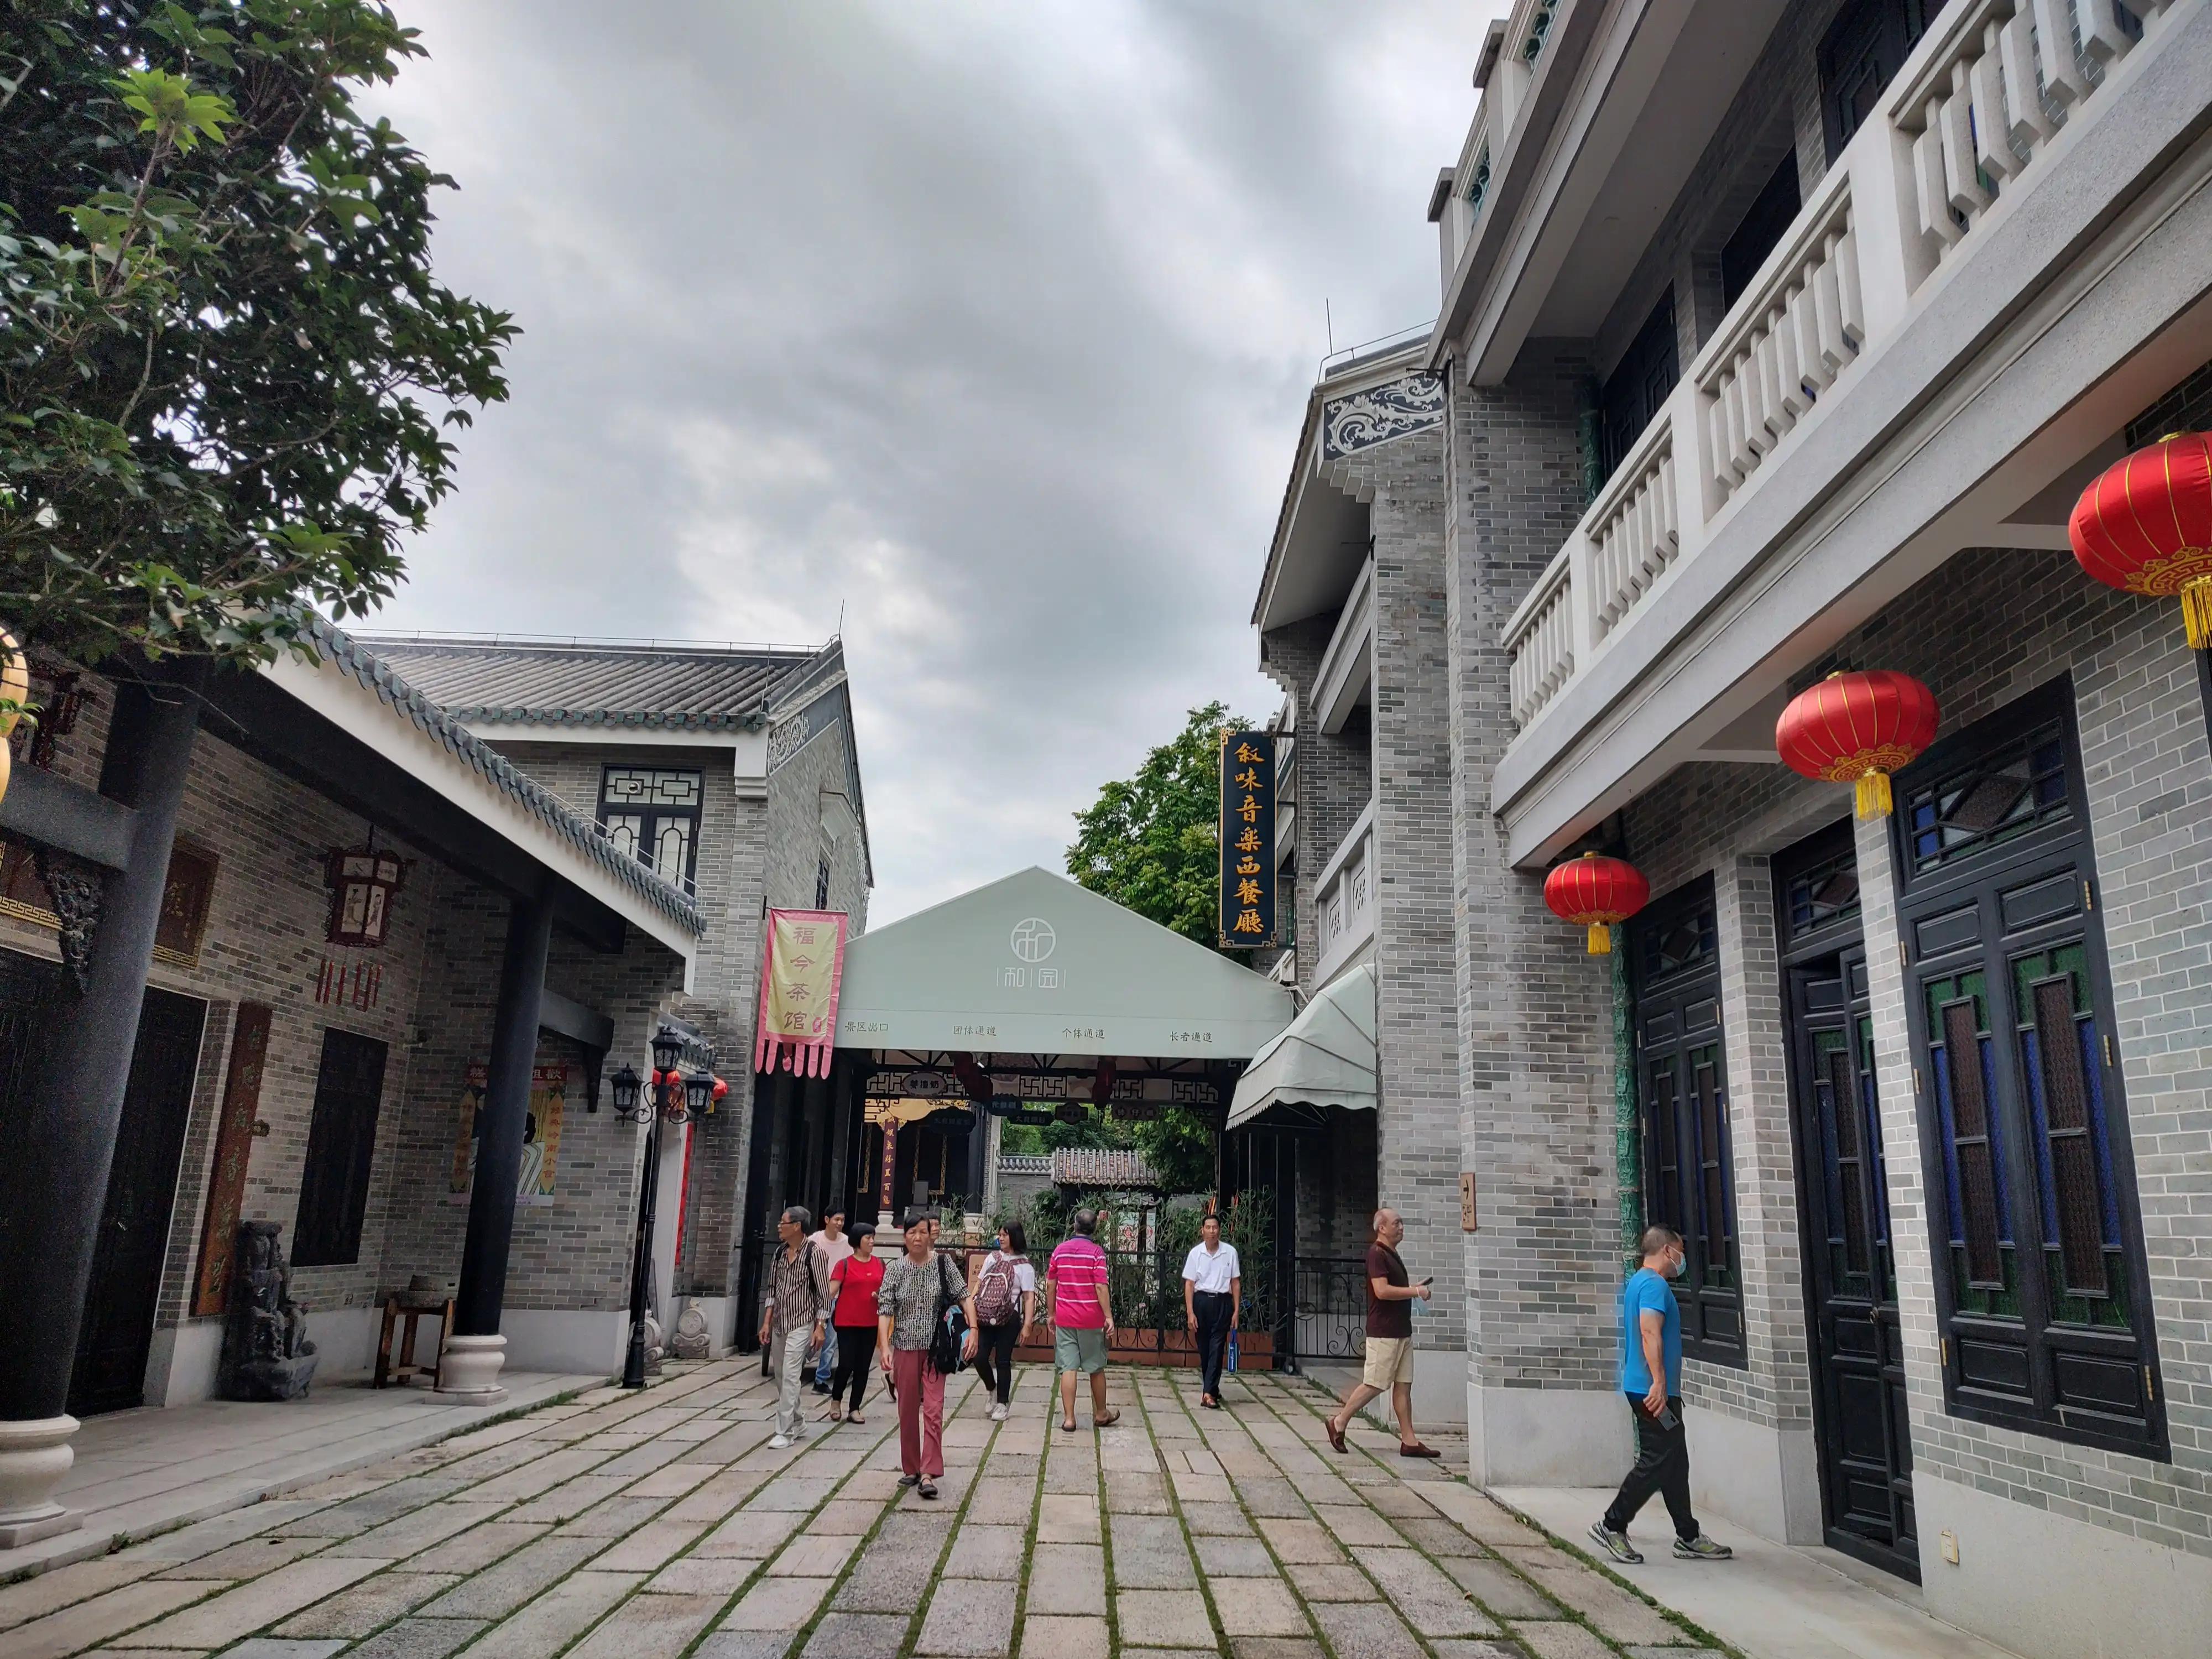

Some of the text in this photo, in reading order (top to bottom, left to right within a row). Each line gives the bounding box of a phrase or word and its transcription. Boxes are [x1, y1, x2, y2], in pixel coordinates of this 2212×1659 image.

[784, 926, 817, 1030] 福今茶馆
[1004, 967, 1058, 988] 和园
[845, 1021, 889, 1032] 景区出口
[953, 1025, 997, 1036] 团体通道
[1062, 1028, 1105, 1040] 个体通道
[1170, 1031, 1213, 1043] 长者通道
